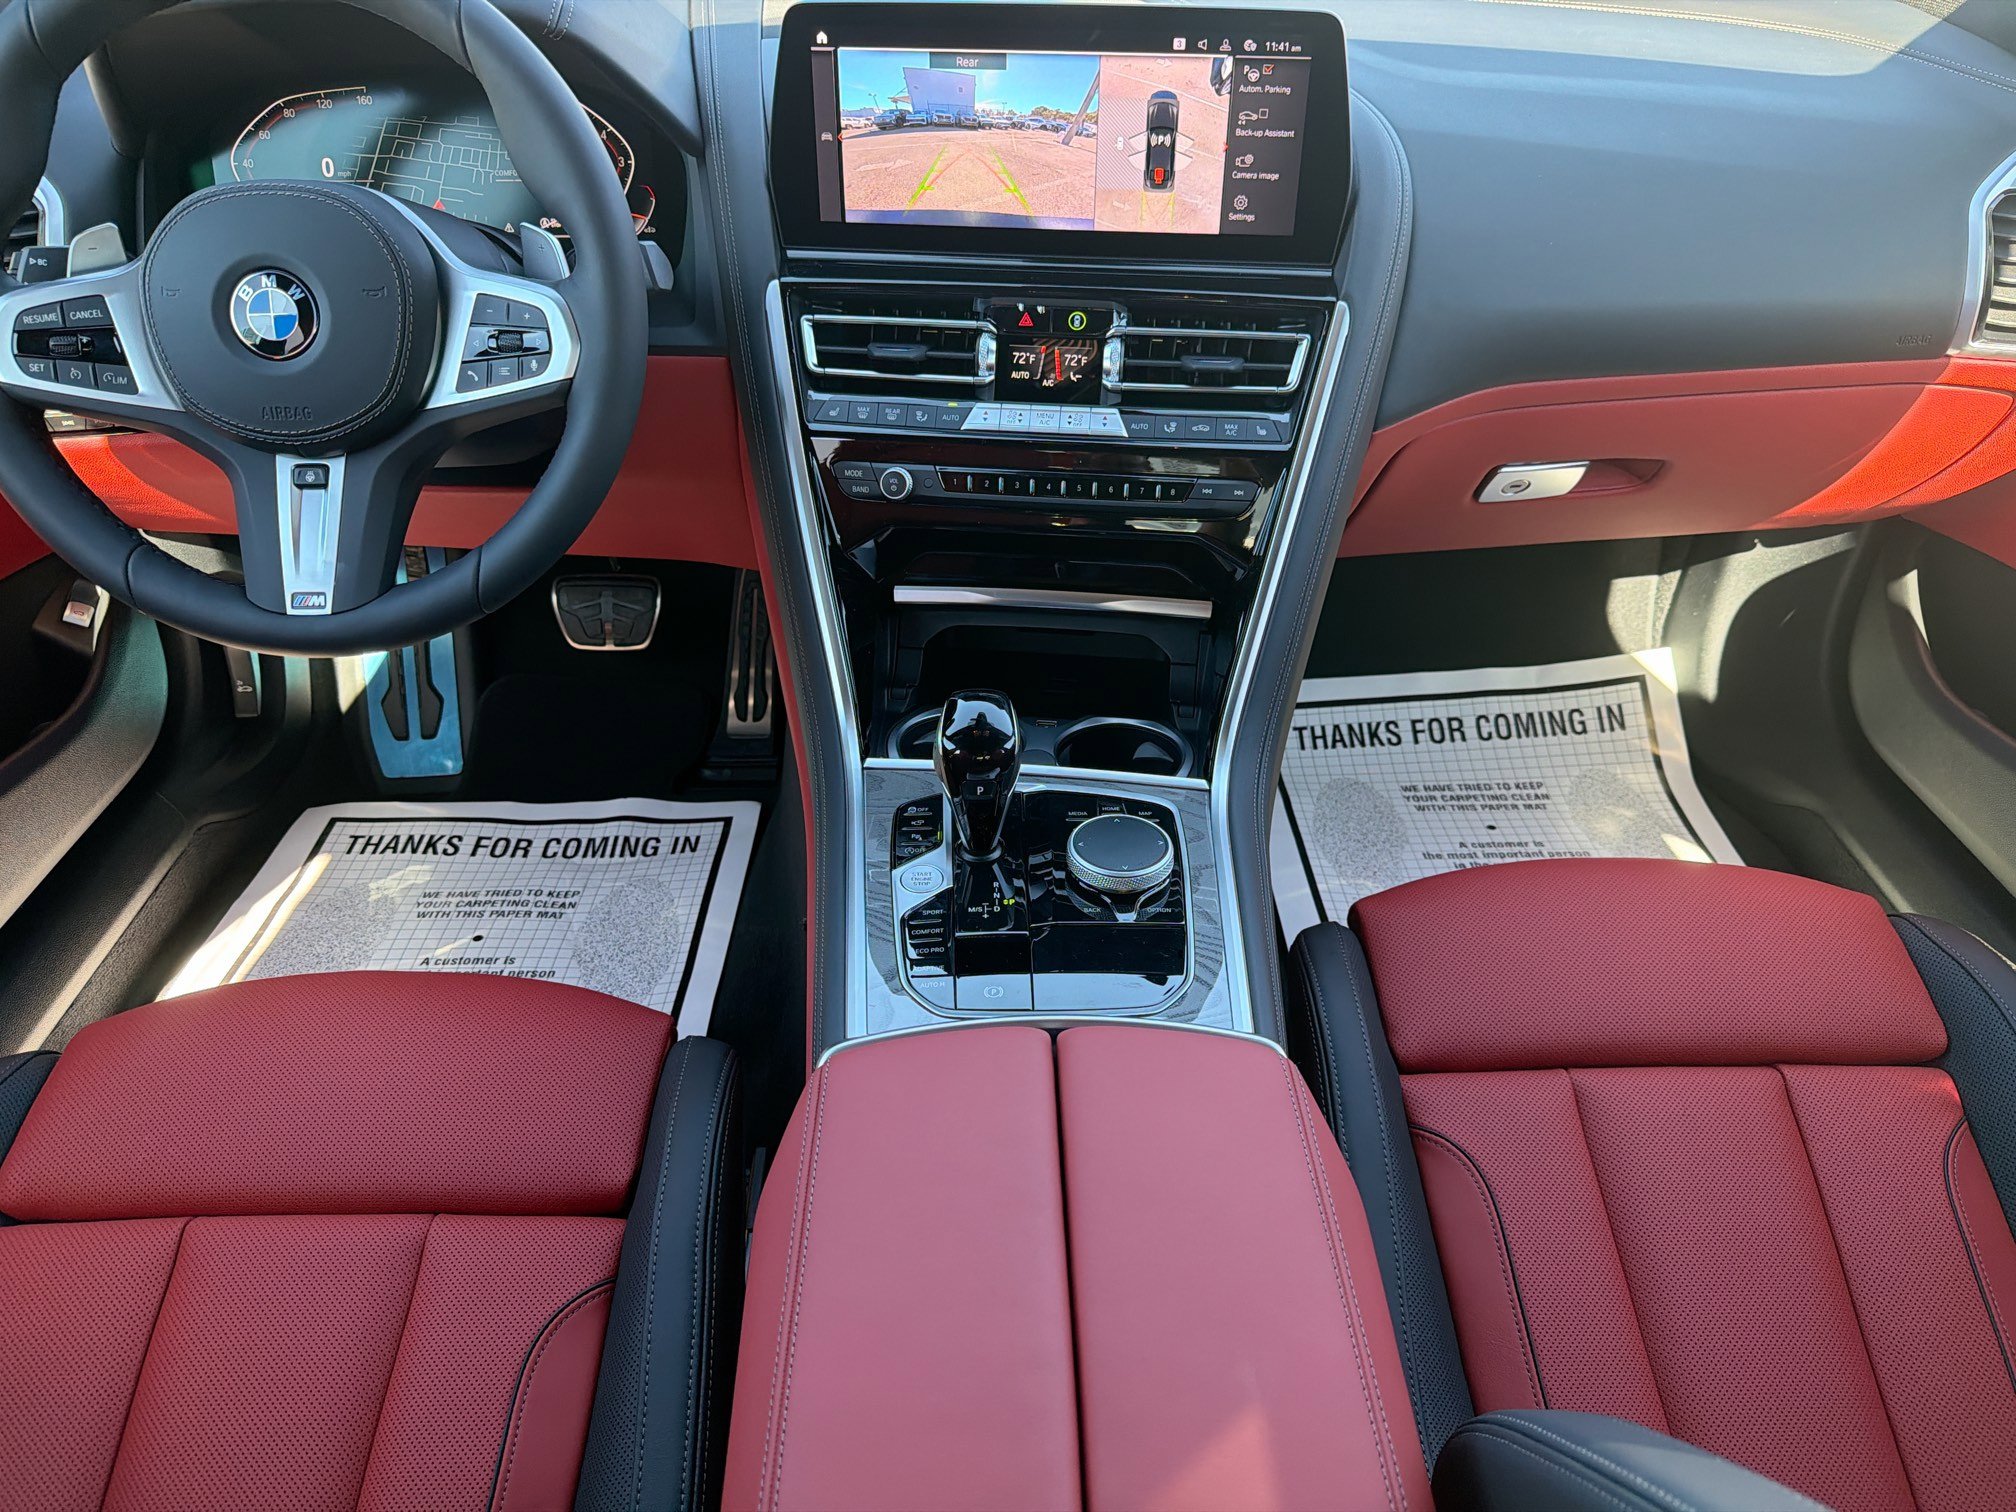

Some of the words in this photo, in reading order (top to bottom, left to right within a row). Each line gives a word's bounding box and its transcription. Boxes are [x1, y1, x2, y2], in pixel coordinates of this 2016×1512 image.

[1265, 41, 1289, 52] 11:41
[956, 56, 978, 68] Rear
[1239, 84, 1263, 93] Autom.
[1264, 85, 1291, 95] Parking
[316, 99, 333, 109] 120
[356, 96, 373, 105] 160
[283, 109, 296, 118] 80
[258, 130, 271, 140] 60
[600, 130, 607, 141] 4
[1235, 128, 1263, 138] Back-up
[1264, 129, 1295, 138] Assistant
[242, 159, 254, 168] 40
[618, 156, 625, 167] 3
[321, 157, 334, 178] 0
[337, 170, 351, 178] mph
[1232, 171, 1257, 180] Camera
[1259, 172, 1280, 181] image
[1228, 212, 1255, 222] Settings
[238, 274, 306, 301] BMW
[22, 312, 58, 325] RESUME
[69, 309, 104, 320] CANCEL
[29, 363, 45, 373] SET
[112, 376, 128, 385] LIM
[1011, 371, 1030, 380] AUTO
[1042, 379, 1054, 387] A/C
[262, 406, 313, 421] AIRBAG
[1130, 423, 1148, 431] AUTO
[844, 470, 863, 478] MODE
[852, 486, 870, 494] BAND
[1292, 720, 1402, 750] THANKS
[1410, 717, 1466, 745] FOR
[1475, 708, 1588, 741] COMING
[1596, 703, 1626, 733] IN
[976, 786, 984, 795] P
[1400, 784, 1419, 793] WE
[1423, 784, 1451, 793] HAVE
[1456, 782, 1495, 792] TRIED
[1496, 782, 1512, 791] TO
[1514, 781, 1544, 790] KEEP
[1403, 795, 1437, 803] YOUR
[1440, 793, 1509, 802] CARPETING
[1511, 793, 1551, 802] CLEAN
[1414, 804, 1450, 812] WITH
[1451, 804, 1477, 812] THIS
[1480, 803, 1520, 812] PAPER
[1523, 803, 1548, 811] MAT
[346, 834, 464, 856] THANKS
[470, 836, 533, 858] FOR
[542, 835, 661, 859] COMING
[671, 835, 701, 855] IN
[1458, 841, 1468, 849] A
[1471, 841, 1529, 849] customer
[1533, 840, 1545, 848] is
[1423, 852, 1443, 860] the
[1446, 851, 1479, 860] most
[1482, 850, 1544, 860] important
[1547, 850, 1591, 858] person
[1453, 861, 1467, 869] in
[423, 891, 443, 899] WE
[446, 890, 480, 898] HAVE
[484, 889, 523, 897] TRIED
[526, 889, 544, 897] TO
[547, 890, 581, 898] KEEP
[416, 901, 453, 909] YOUR
[456, 900, 530, 908] CARPETING
[533, 900, 577, 909] CLEAN
[417, 910, 451, 918] WITH
[455, 910, 486, 918] THIS
[489, 910, 534, 918] PAPER
[536, 911, 566, 919] MAT
[911, 927, 944, 935] COMFORT
[420, 957, 430, 966] A
[434, 957, 500, 966] customer
[503, 956, 516, 965] is
[508, 969, 556, 978] person
